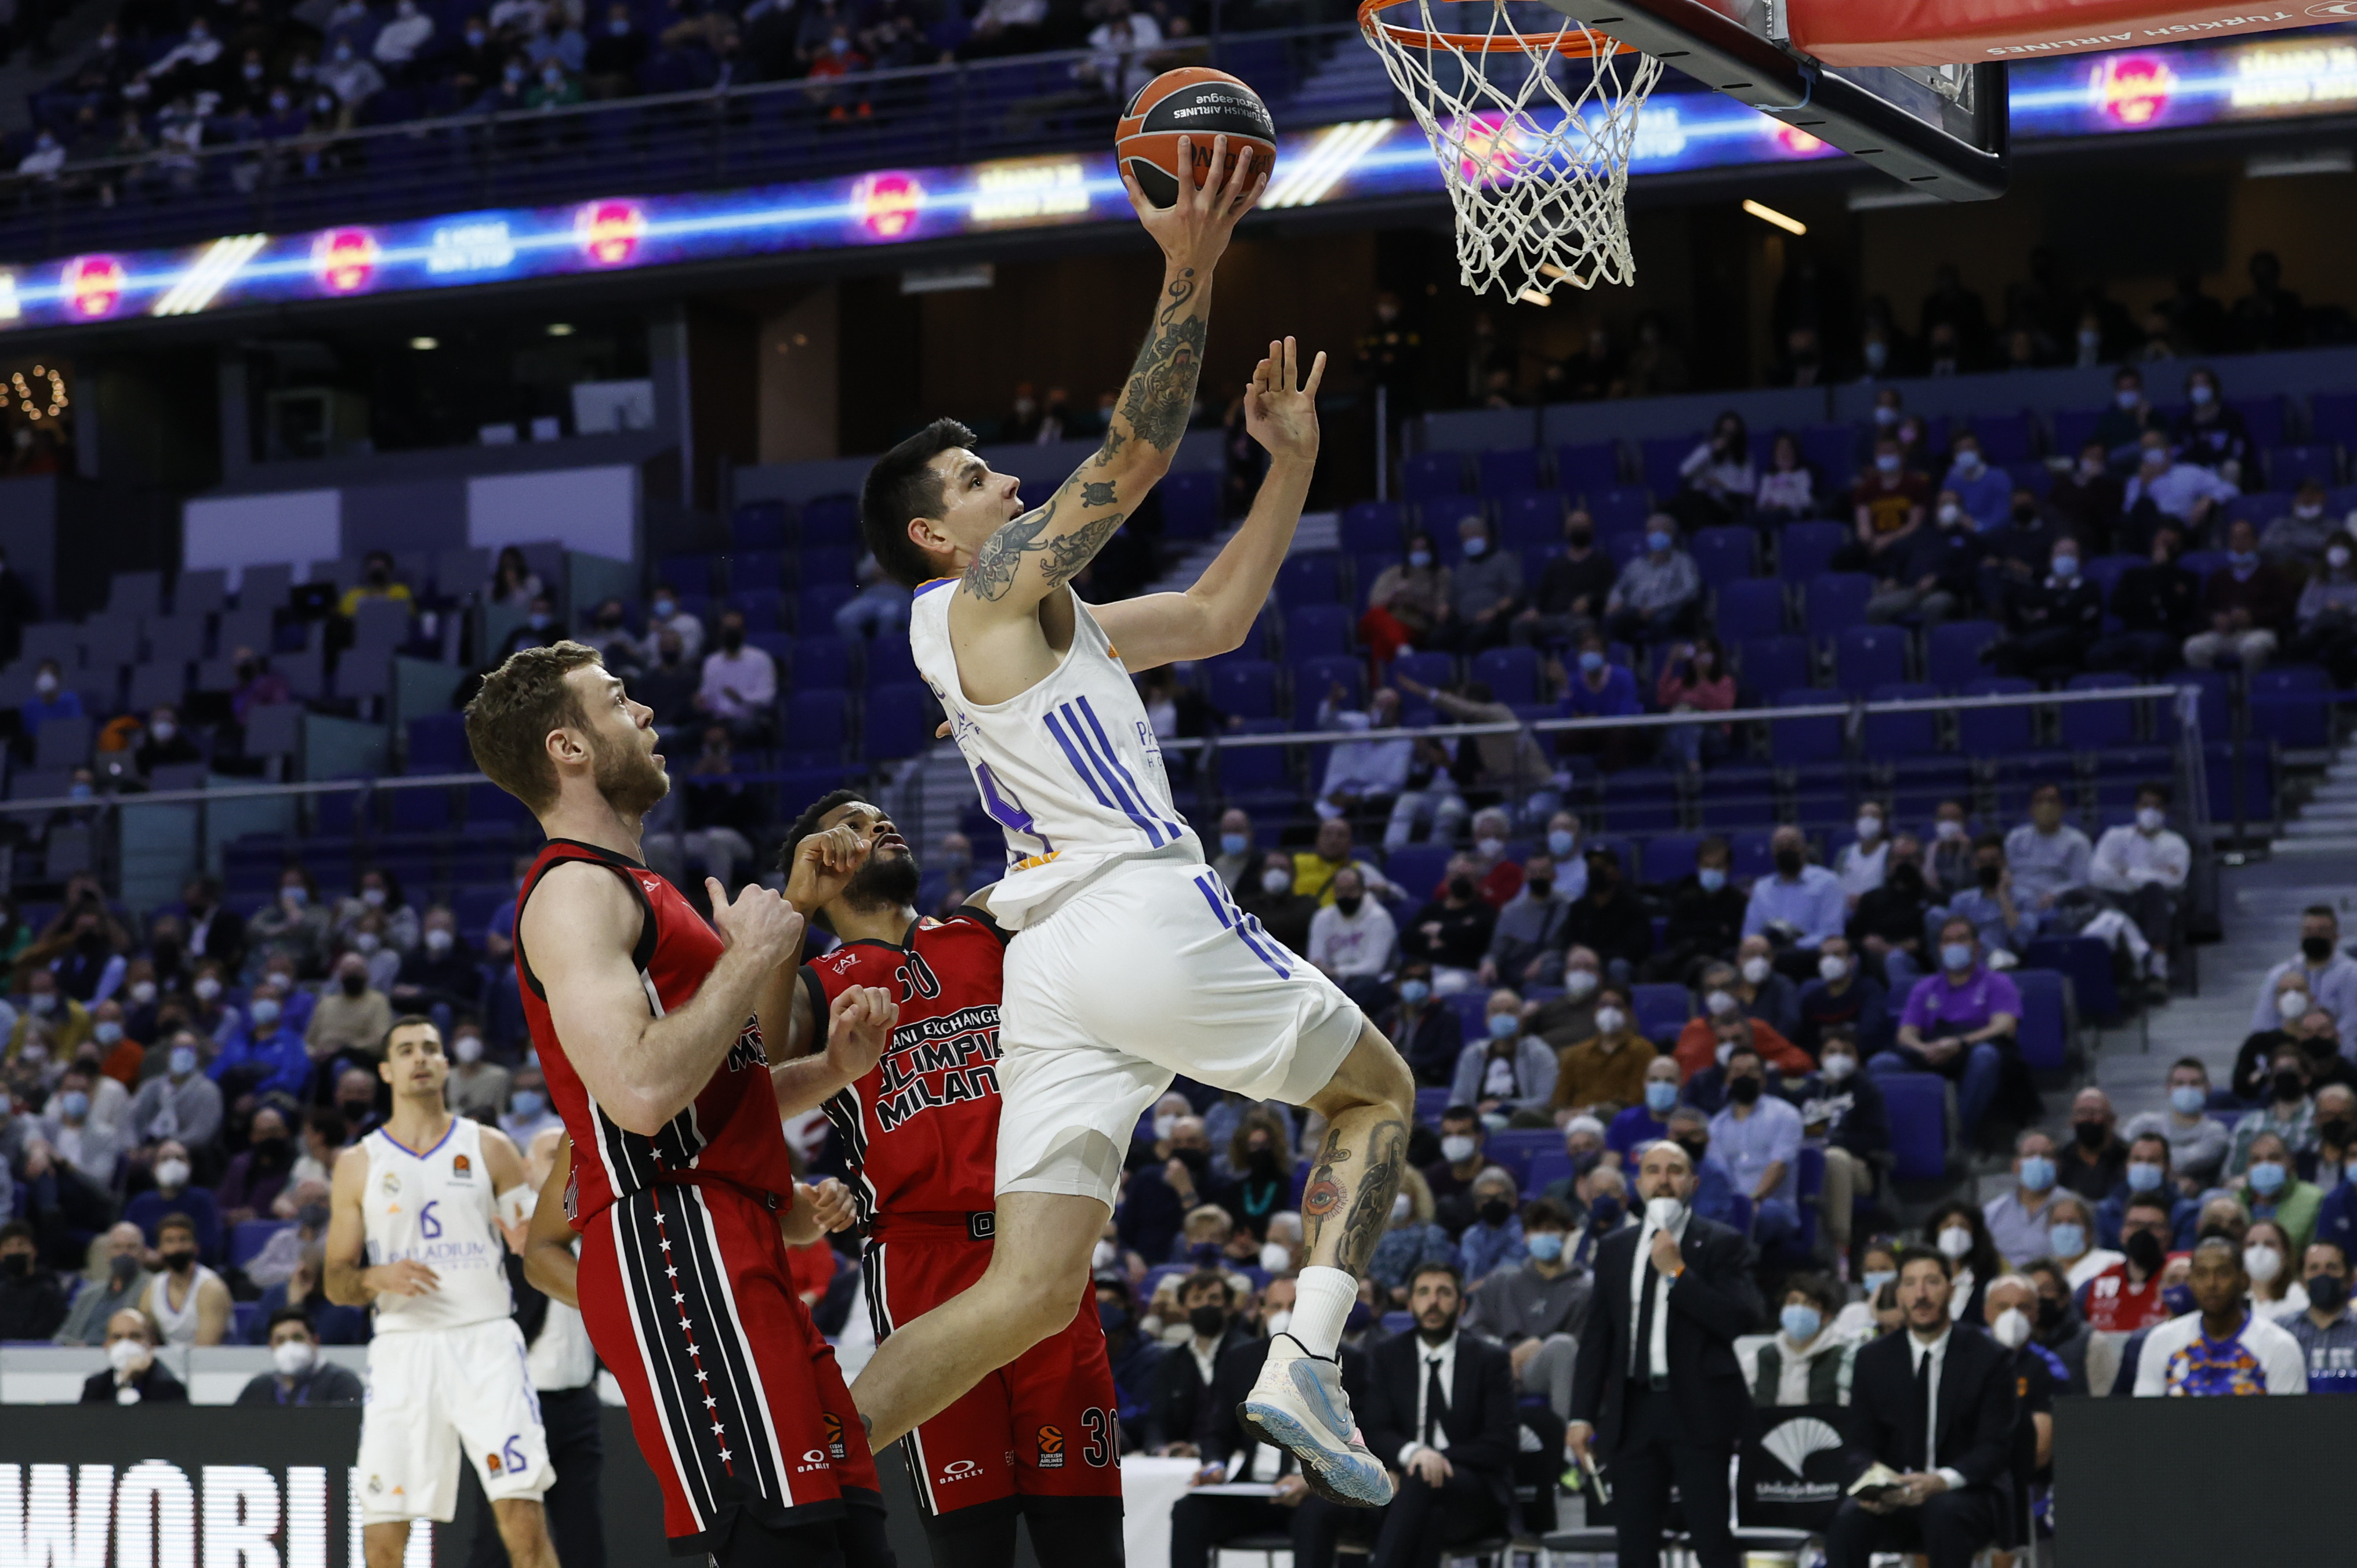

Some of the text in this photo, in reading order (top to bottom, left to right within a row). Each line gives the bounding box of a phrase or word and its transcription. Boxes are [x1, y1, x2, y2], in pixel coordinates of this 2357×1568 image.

[1986, 11, 2293, 56] TURKISH AIRLINES
[1173, 106, 1262, 124] TURKISH AIRLINES
[1196, 93, 1260, 113] EuroLeague
[832, 953, 855, 974] EA7
[923, 1010, 1000, 1036] EXCHANGE
[420, 1199, 443, 1240] 6
[1081, 1407, 1121, 1469] 30
[503, 1433, 527, 1473] 6
[939, 1468, 984, 1484] OAKLEY
